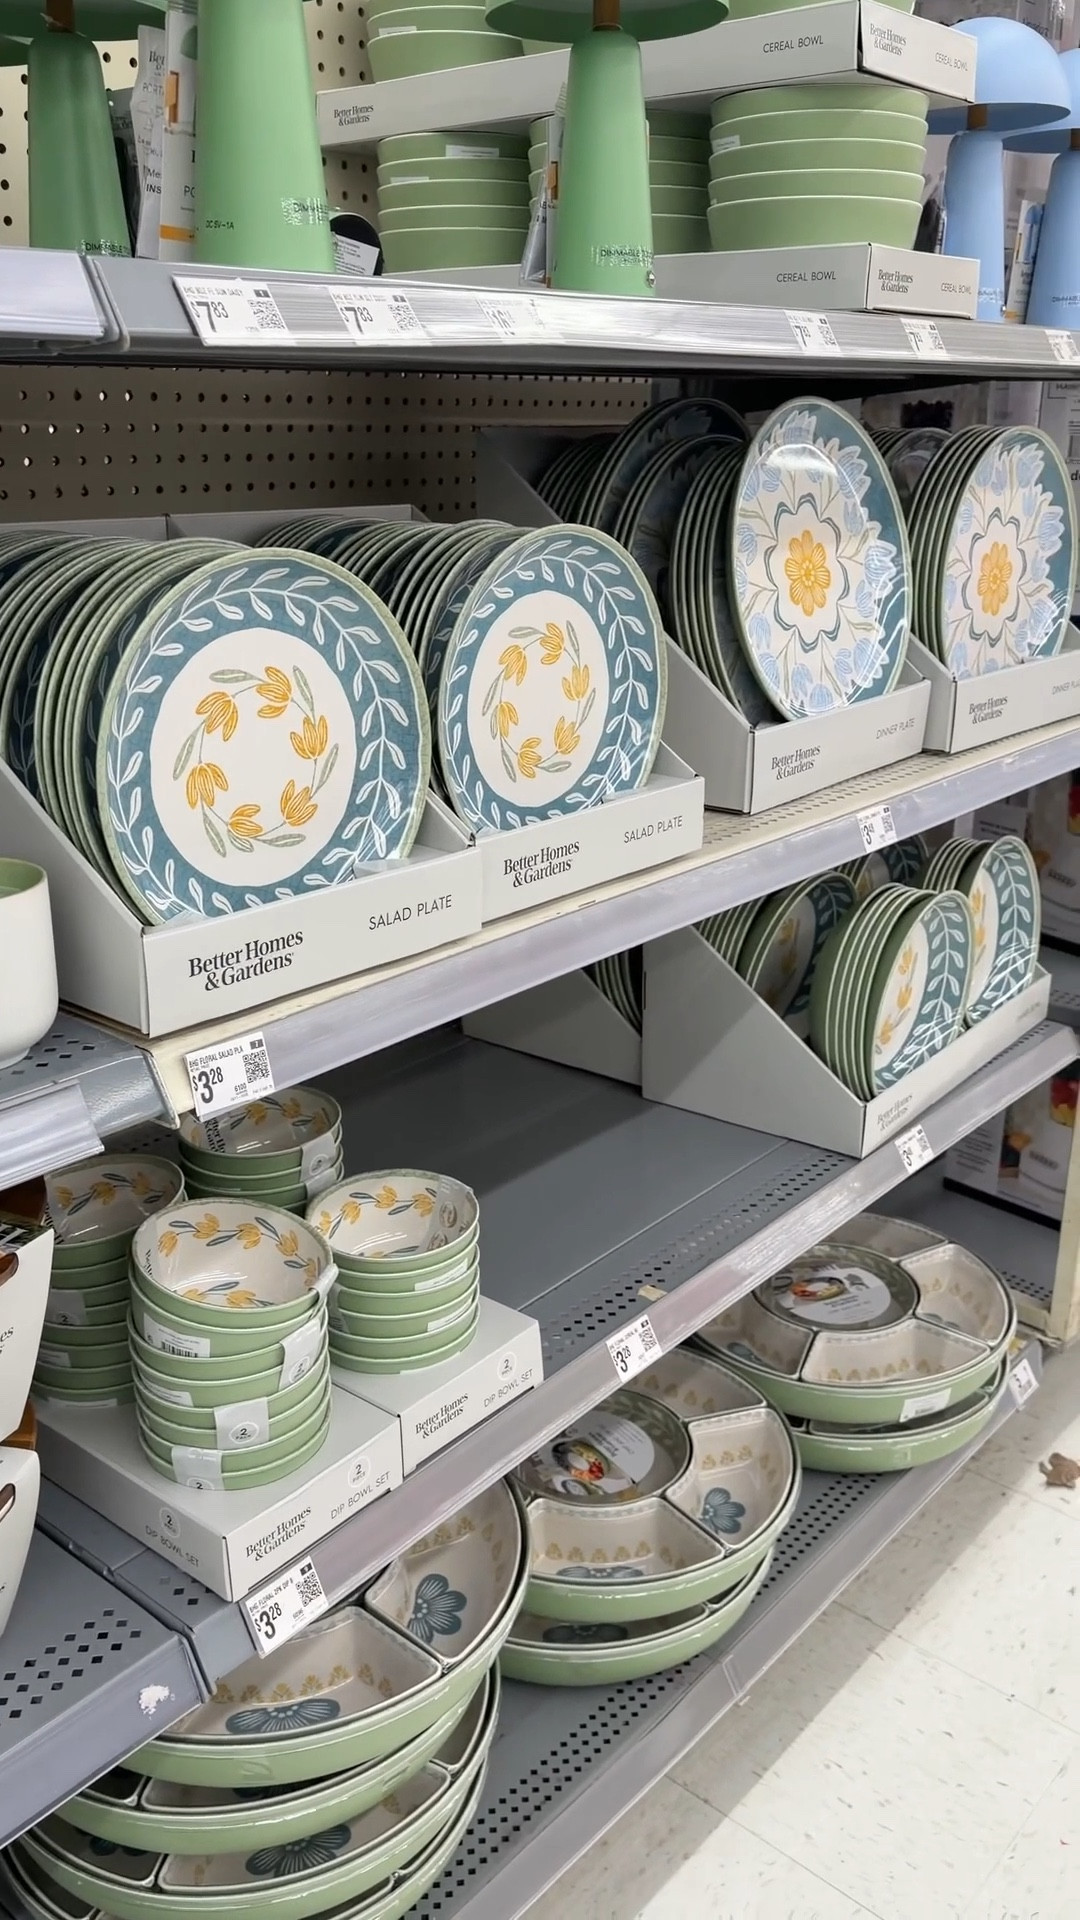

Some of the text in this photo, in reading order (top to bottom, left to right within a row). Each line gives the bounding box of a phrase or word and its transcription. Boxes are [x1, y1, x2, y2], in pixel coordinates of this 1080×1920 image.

[763, 35, 824, 53] CEREAL BOWL
[935, 52, 968, 71] CEREAL BOWL
[776, 271, 836, 282] CEREAL BOWL
[940, 282, 957, 292] CEREAL
[958, 284, 972, 294] BOWL
[876, 718, 915, 740] DINNER PLATE
[771, 745, 821, 770] Better Homes
[624, 816, 683, 844] SALAD PLATE
[503, 841, 580, 876] Better Homes
[368, 894, 452, 930] SALAD PLATE
[188, 930, 304, 978] Better Homes
[218, 1048, 234, 1060] SALAD
[234, 1046, 244, 1054] PLA
[504, 1359, 510, 1369] 2
[484, 1368, 533, 1408] DIP BOWL SET
[416, 1393, 469, 1434] Better Homes
[240, 1428, 248, 1436] 2
[356, 1464, 362, 1476] 2
[330, 1470, 390, 1520] DIP BOWL SET
[166, 1514, 173, 1526] 2
[246, 1506, 312, 1558] Better Homes
